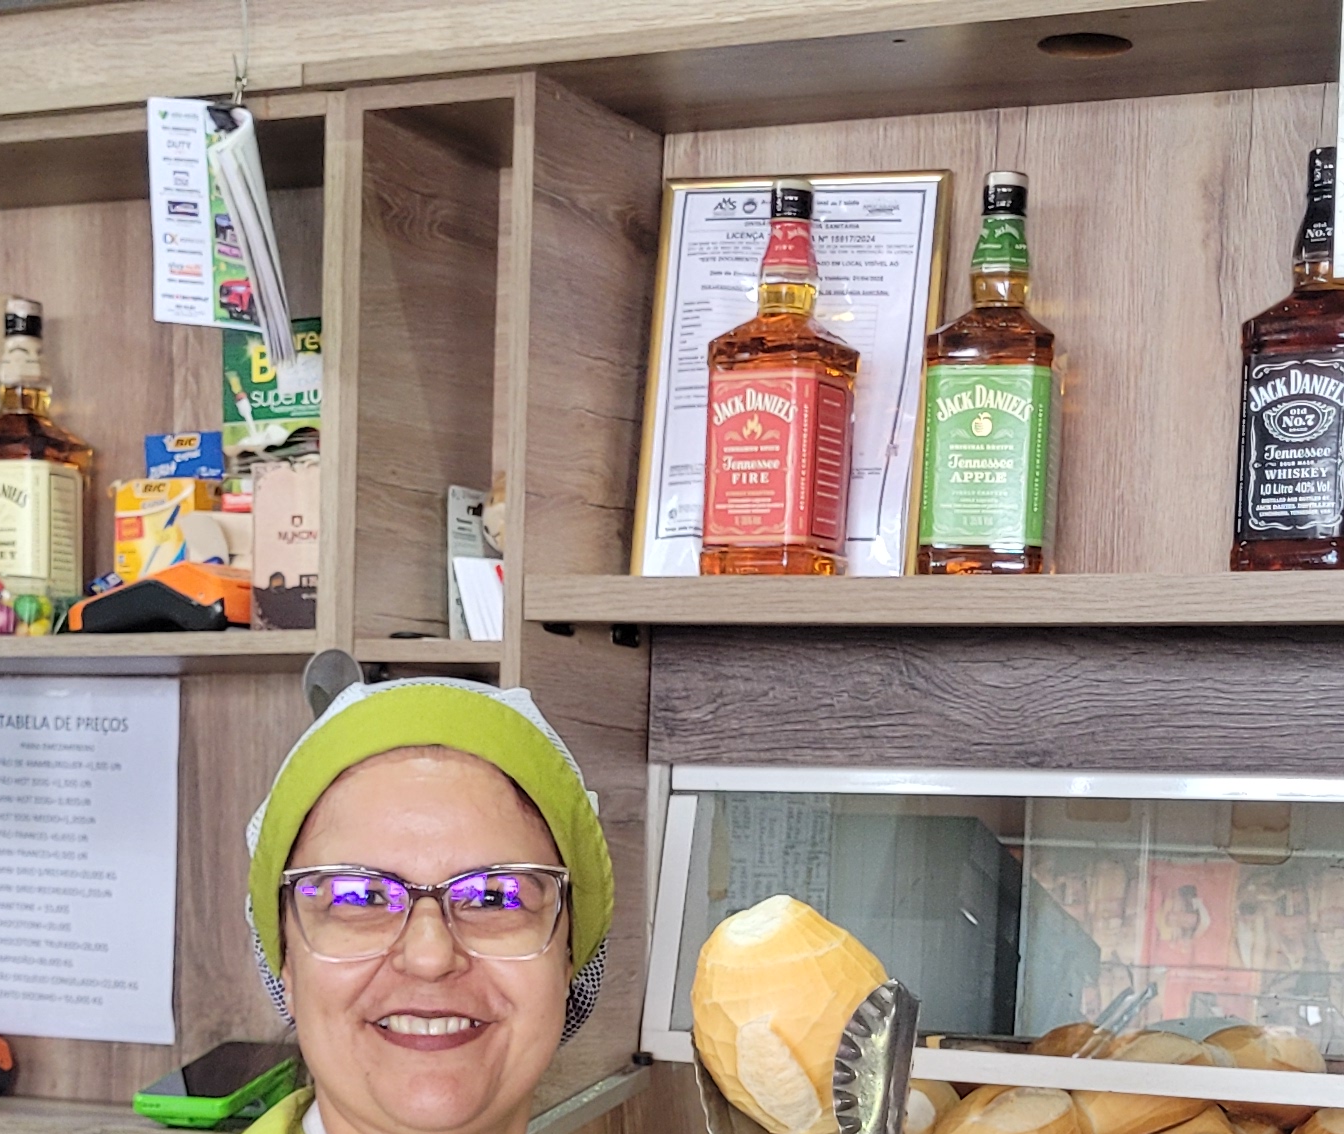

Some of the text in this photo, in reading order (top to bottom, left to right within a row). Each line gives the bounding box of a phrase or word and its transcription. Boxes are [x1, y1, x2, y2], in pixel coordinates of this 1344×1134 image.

[726, 232, 765, 241] LICENÇA
[1305, 227, 1334, 239] No.7
[1249, 376, 1289, 412] JACK
[713, 388, 799, 426] JACK DANIEL'S
[936, 384, 1035, 422] JACK DANIEL'S
[1290, 407, 1308, 415] Old
[1281, 414, 1316, 428] No.7
[1264, 445, 1332, 460] Tennessee
[722, 455, 780, 470] Tennessee
[948, 453, 1015, 470] Tennessee
[731, 471, 770, 484] FIRE
[950, 471, 1008, 484] APPLE
[1264, 467, 1329, 480] WHISKEY
[142, 483, 167, 493] BIC
[1272, 482, 1294, 495] Litre
[1295, 481, 1315, 494] 40%
[55, 715, 71, 731] DE
[76, 717, 129, 735] PREÇOS
